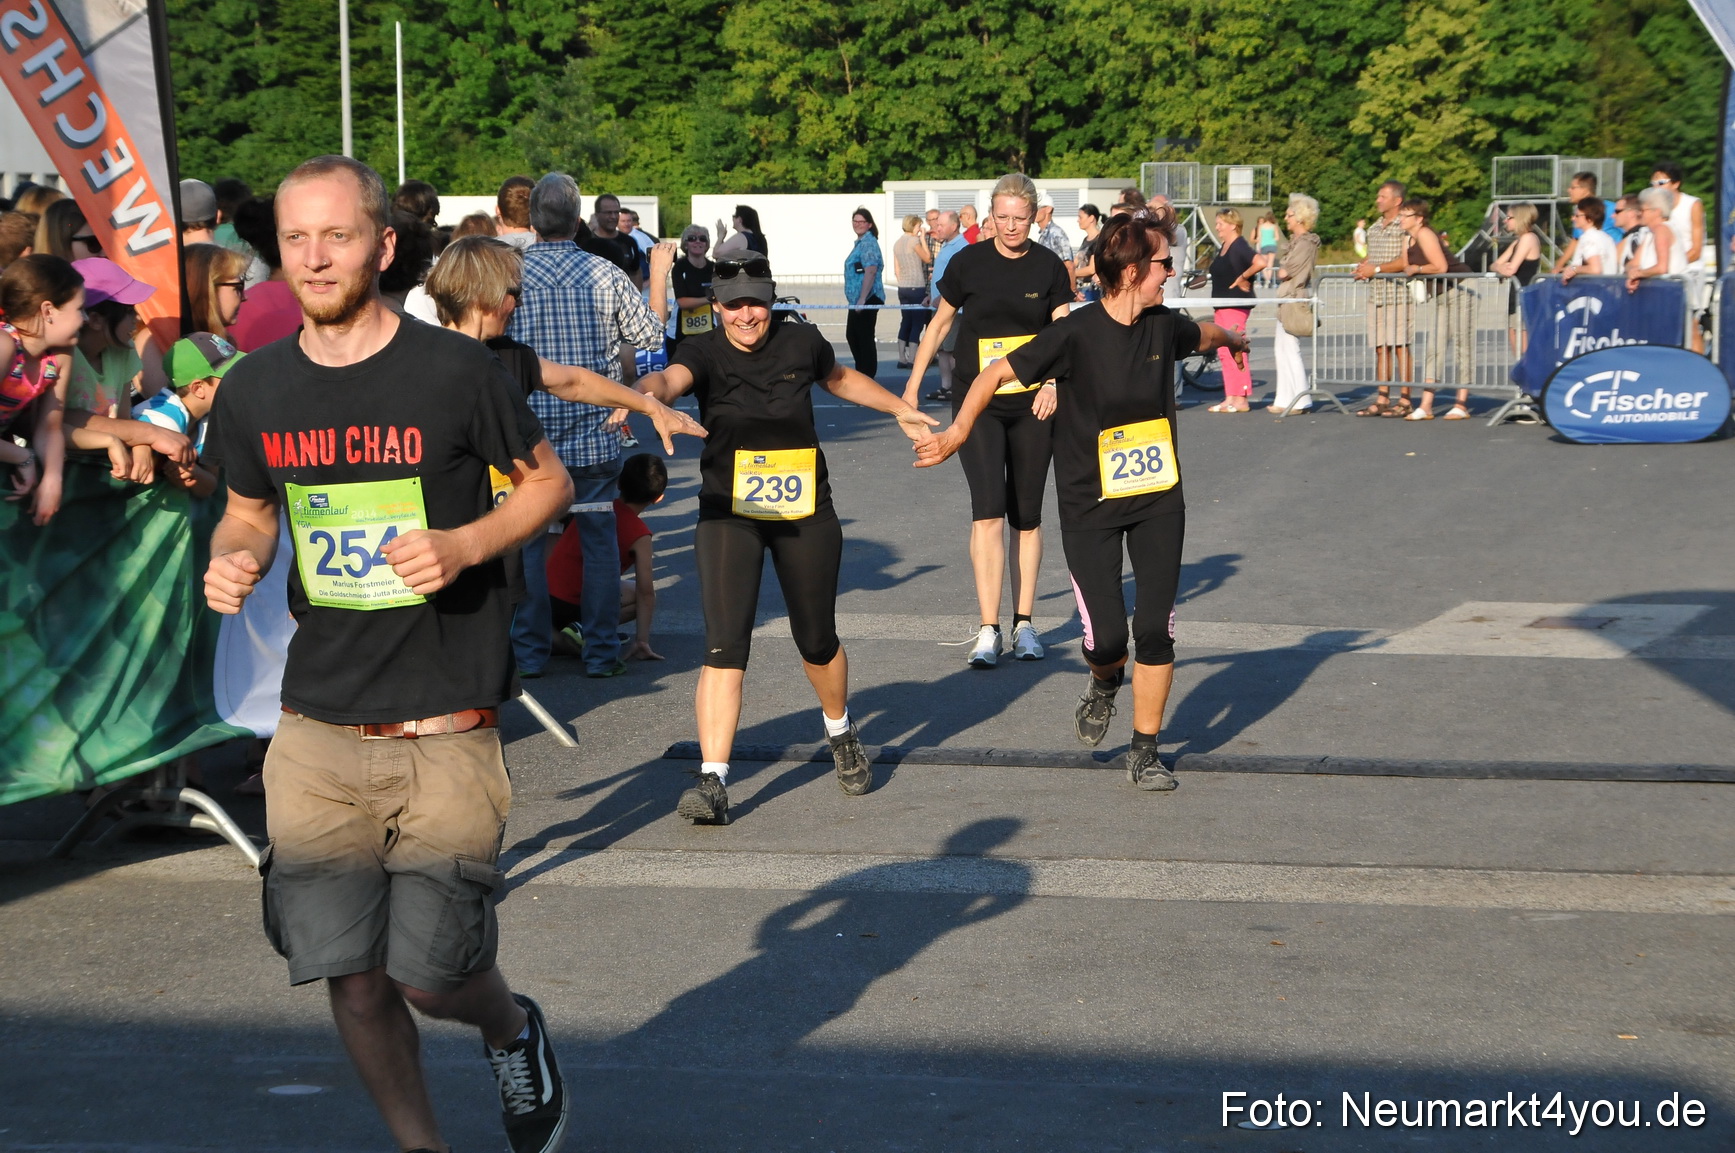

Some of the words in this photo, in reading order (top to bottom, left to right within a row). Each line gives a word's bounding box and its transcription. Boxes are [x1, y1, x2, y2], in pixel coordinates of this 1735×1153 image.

[686, 315, 708, 328] 985
[1563, 327, 1648, 358] Fisch
[636, 362, 668, 376] Fis
[1590, 388, 1709, 412] Fischer
[1601, 411, 1700, 424] AUTOMOBILE
[261, 428, 336, 468] MANU
[345, 425, 422, 464] CHAO
[1110, 445, 1163, 480] 238
[744, 475, 802, 503] 239
[303, 505, 349, 516] firmenlauf
[351, 510, 377, 519] 2014
[309, 525, 399, 579] 254
[332, 580, 353, 588] Marius
[354, 579, 396, 588] Forstmeier
[318, 589, 328, 597] Die
[329, 590, 371, 599] Goldschmiede
[372, 590, 391, 598] Jutta
